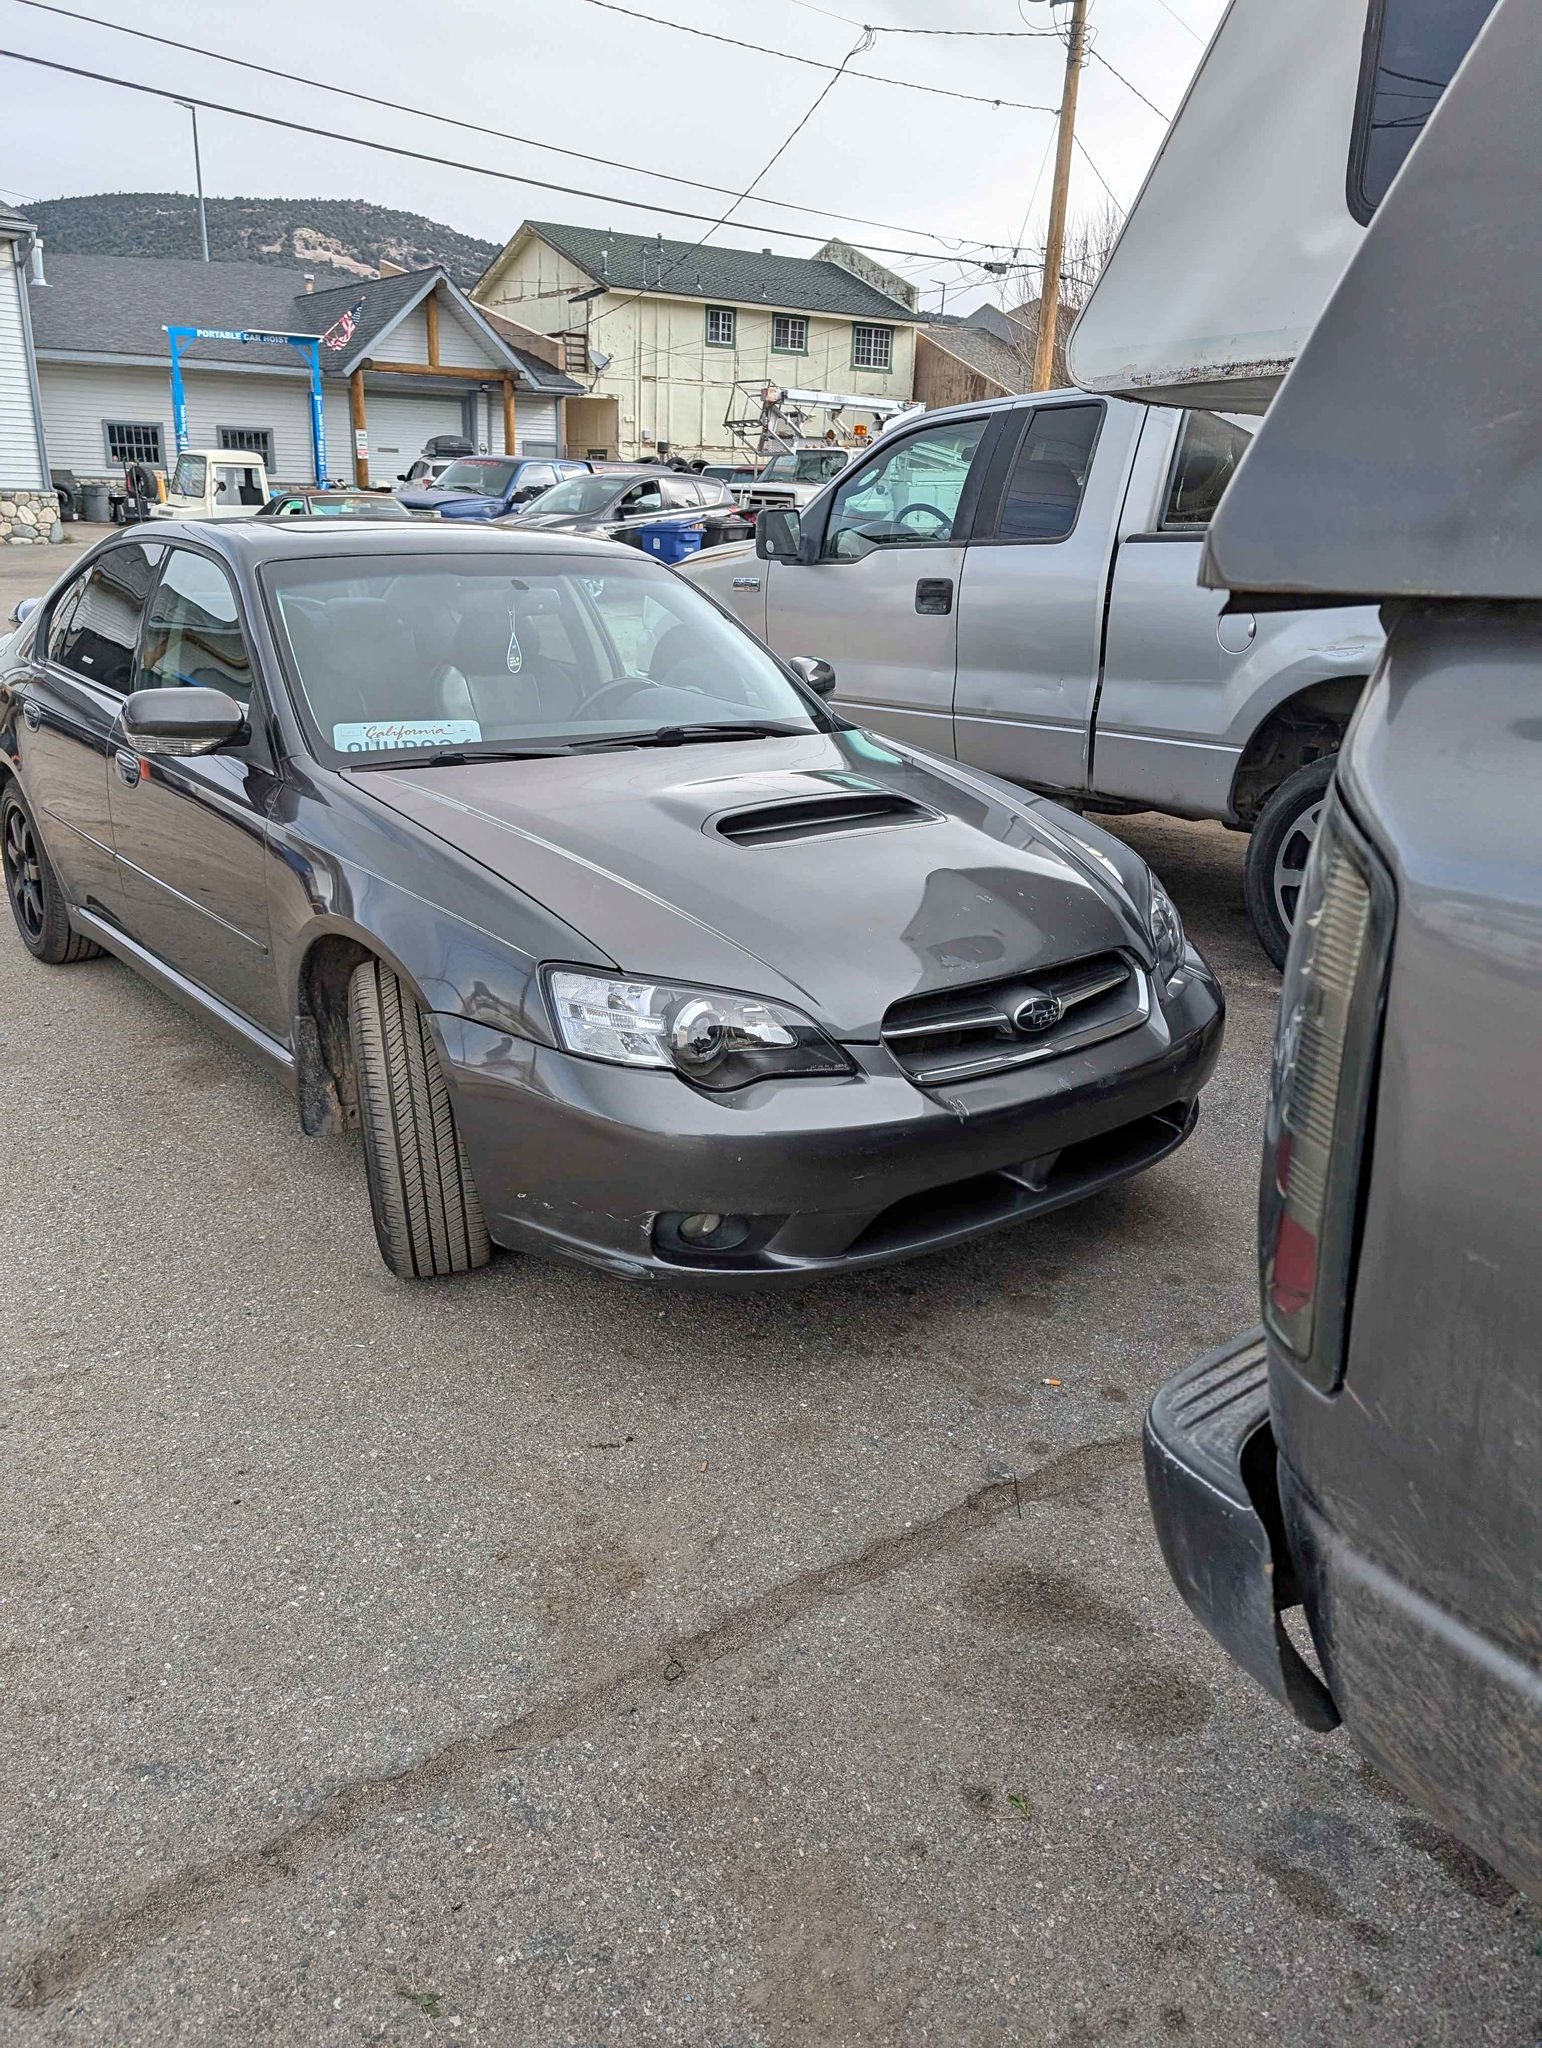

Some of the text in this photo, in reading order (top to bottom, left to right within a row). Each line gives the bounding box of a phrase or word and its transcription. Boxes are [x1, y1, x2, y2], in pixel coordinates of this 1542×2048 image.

[196, 329, 288, 344] PORTABLE CAR HOIST
[365, 725, 453, 739] California
